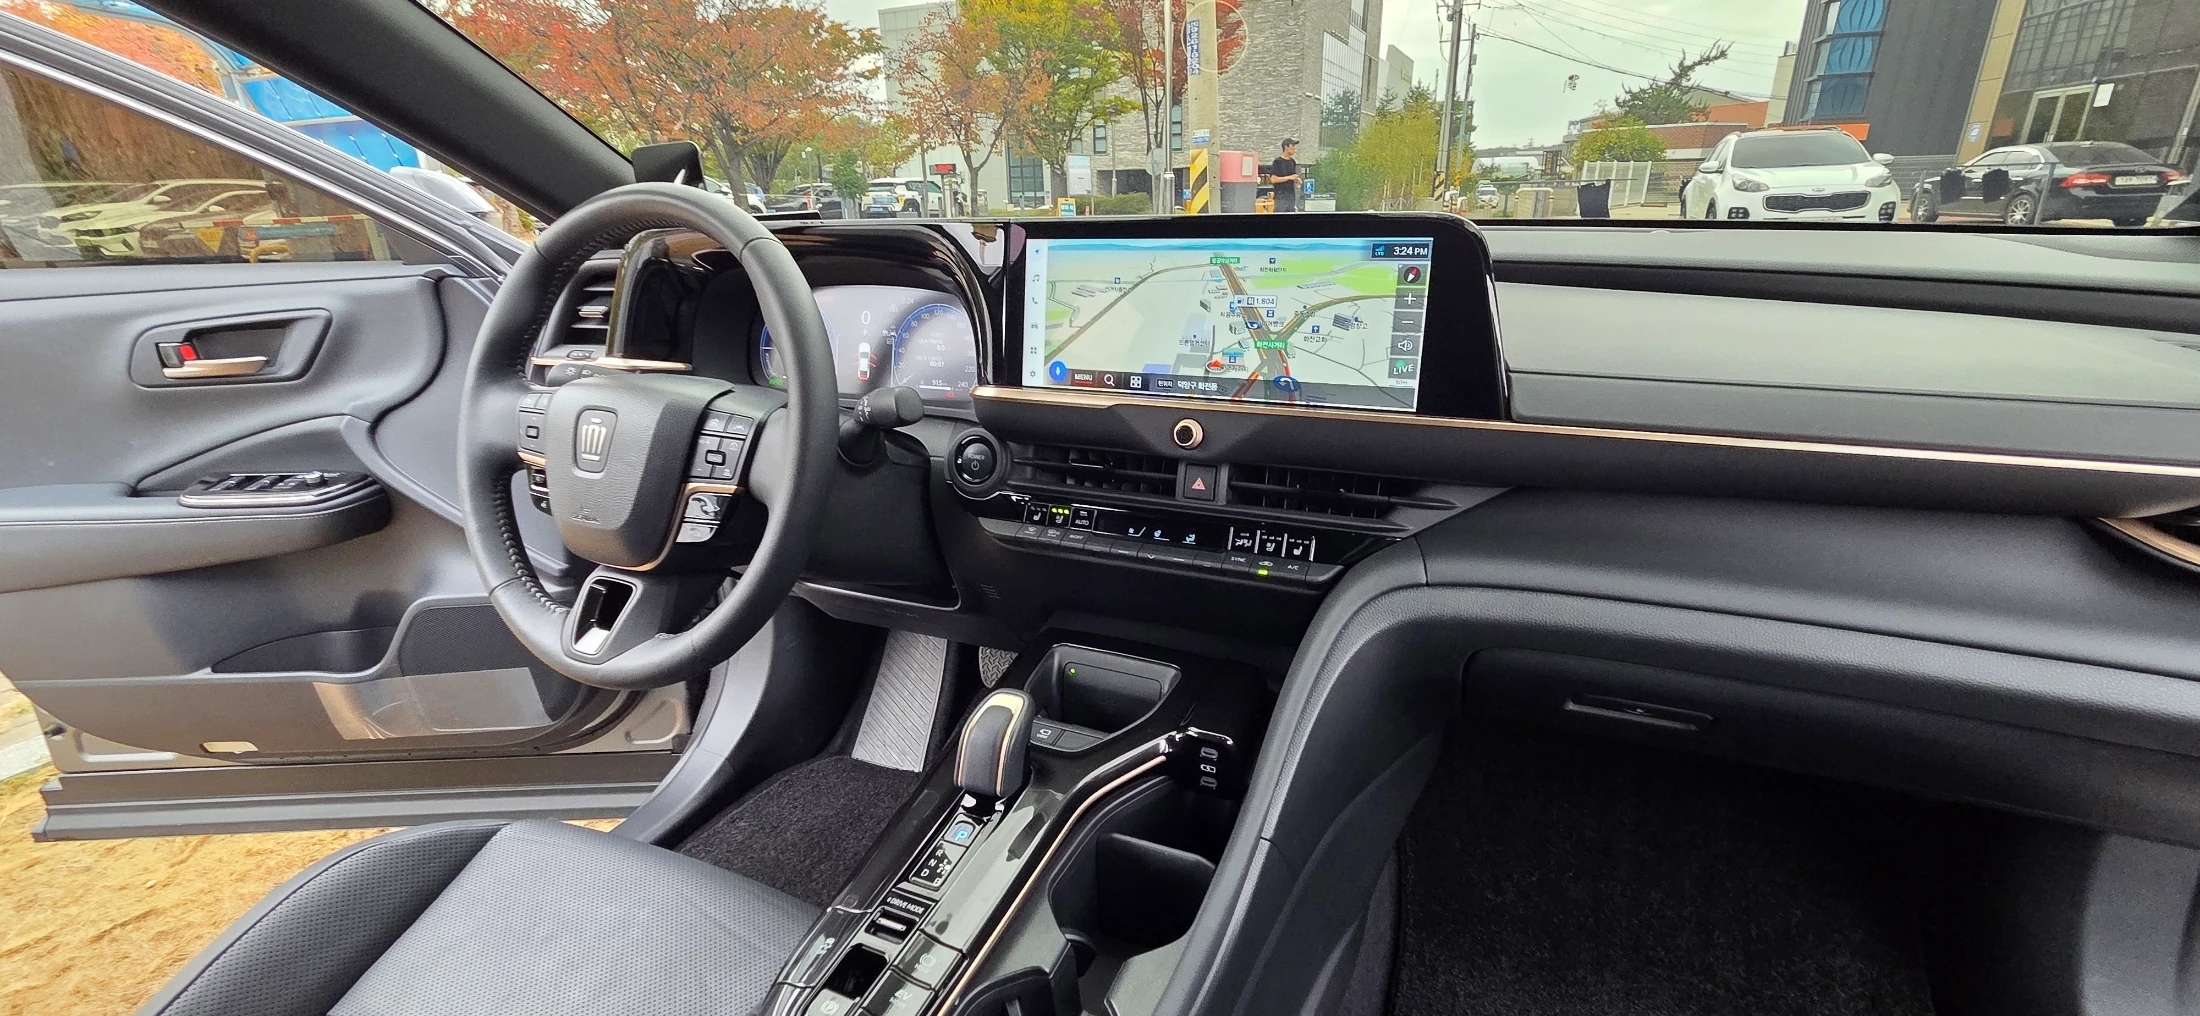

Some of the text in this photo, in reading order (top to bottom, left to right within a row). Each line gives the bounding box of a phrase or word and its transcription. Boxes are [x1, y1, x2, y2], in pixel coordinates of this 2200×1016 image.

[1393, 246, 1428, 256] 3:24 PM
[860, 310, 871, 325] 0
[920, 312, 930, 320] 100
[964, 365, 976, 373] 220
[1392, 363, 1415, 375] LIVE
[1074, 373, 1093, 381] MENU
[957, 381, 969, 389] 240
[1177, 380, 1219, 391] 덕양구 화전동
[967, 453, 985, 461] POWER
[953, 829, 969, 842] P
[935, 849, 944, 858] R
[928, 858, 938, 867] N
[920, 869, 930, 877] D
[889, 897, 925, 914] DRIVE MODE
[894, 989, 913, 1001] EV
